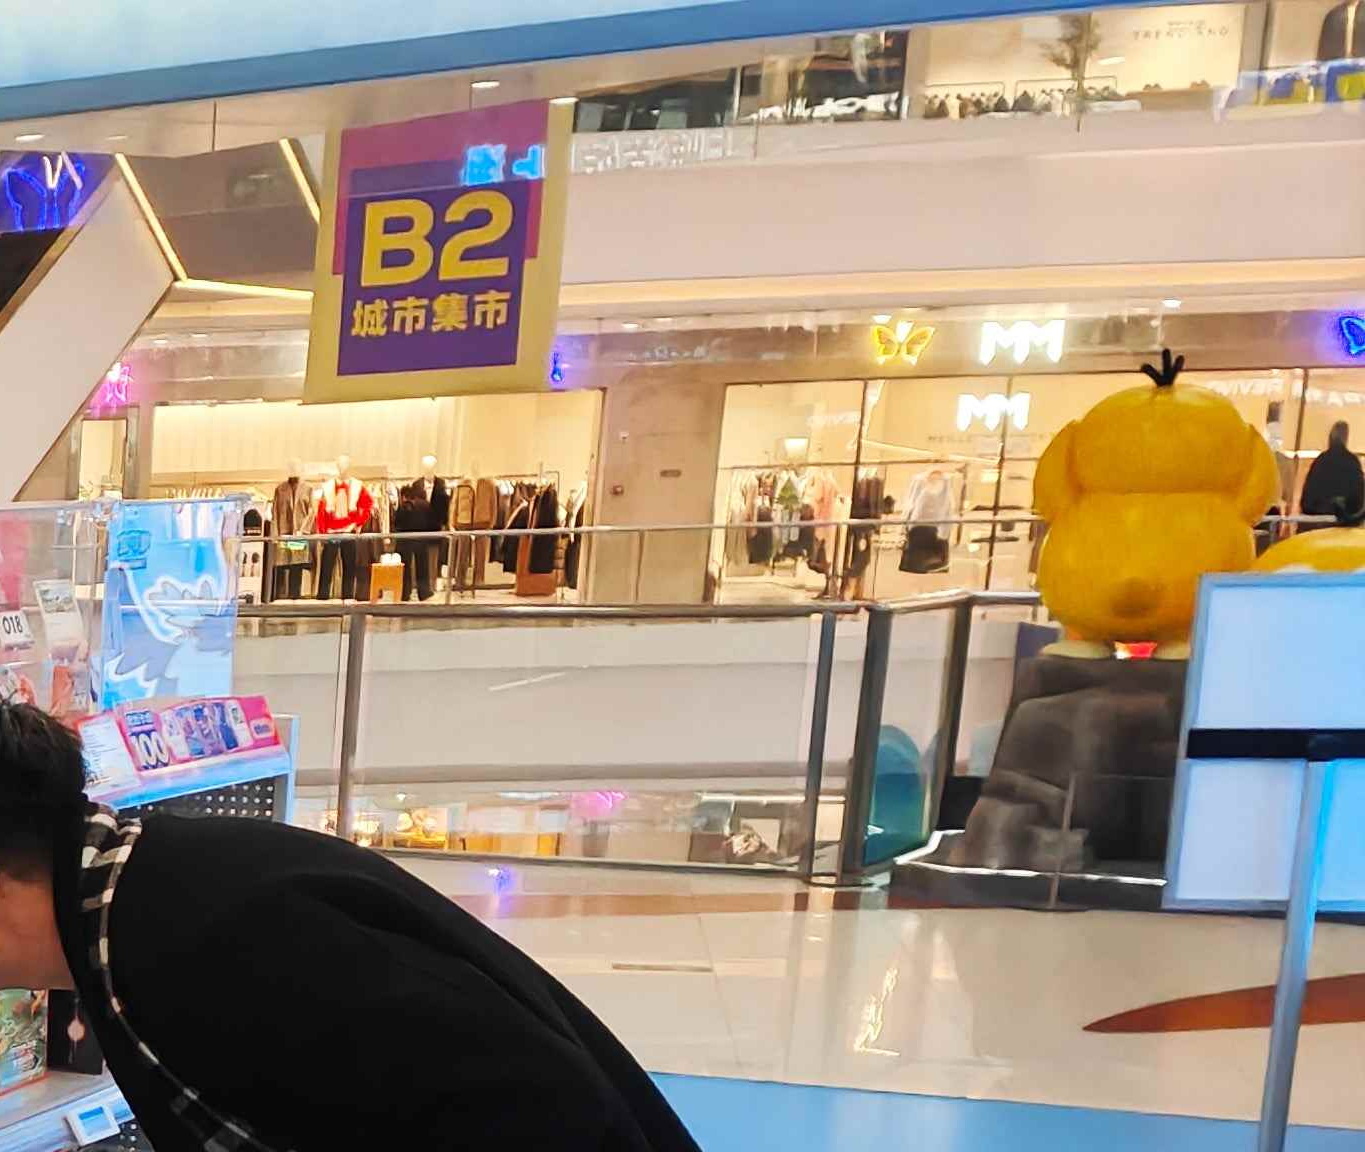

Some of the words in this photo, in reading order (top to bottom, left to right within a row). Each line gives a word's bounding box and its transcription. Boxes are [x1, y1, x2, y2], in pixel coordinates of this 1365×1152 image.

[360, 189, 514, 287] B2
[350, 290, 512, 337] 城市集市
